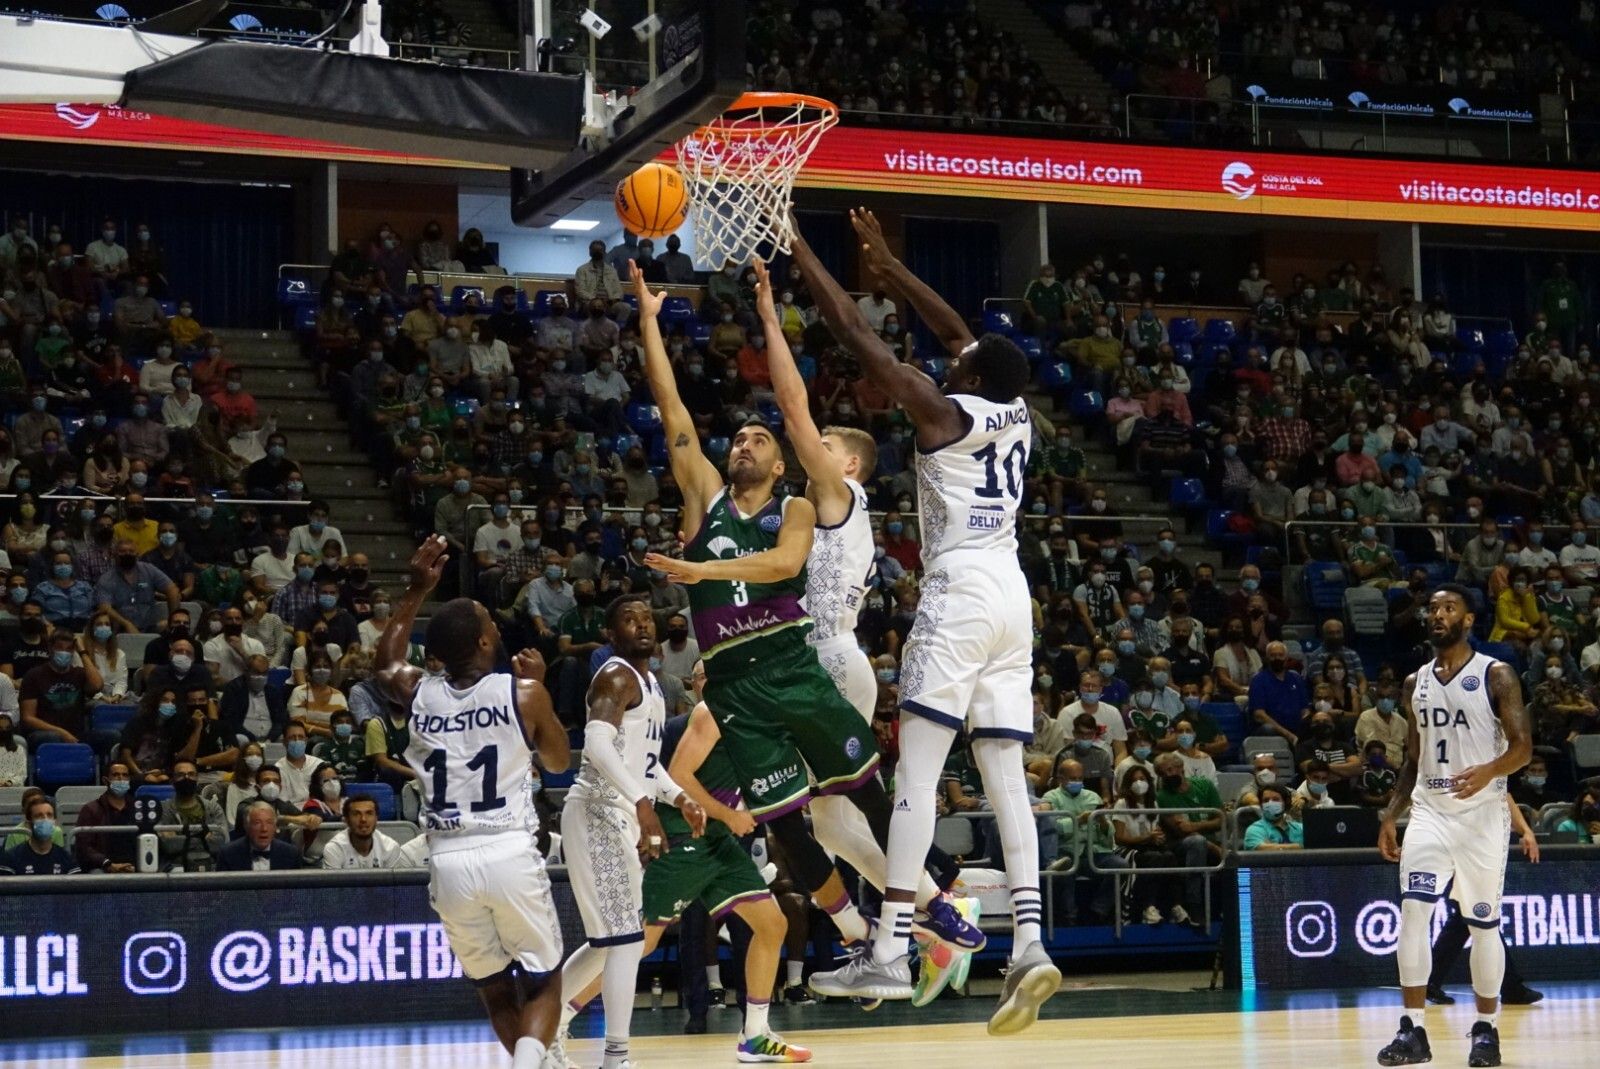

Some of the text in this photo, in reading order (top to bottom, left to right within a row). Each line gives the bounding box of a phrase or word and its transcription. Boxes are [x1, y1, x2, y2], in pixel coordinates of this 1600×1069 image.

[884, 148, 1143, 185] visitacostadelsol.com
[971, 440, 1026, 500] 10
[969, 514, 1004, 529] DELIN
[731, 580, 749, 607] 3
[716, 609, 783, 640] Andalucía
[414, 705, 510, 733] HOLSTON
[1419, 708, 1470, 730] JDA
[1436, 739, 1449, 764] 1
[423, 744, 507, 813] 11
[1409, 873, 1436, 887] Plus
